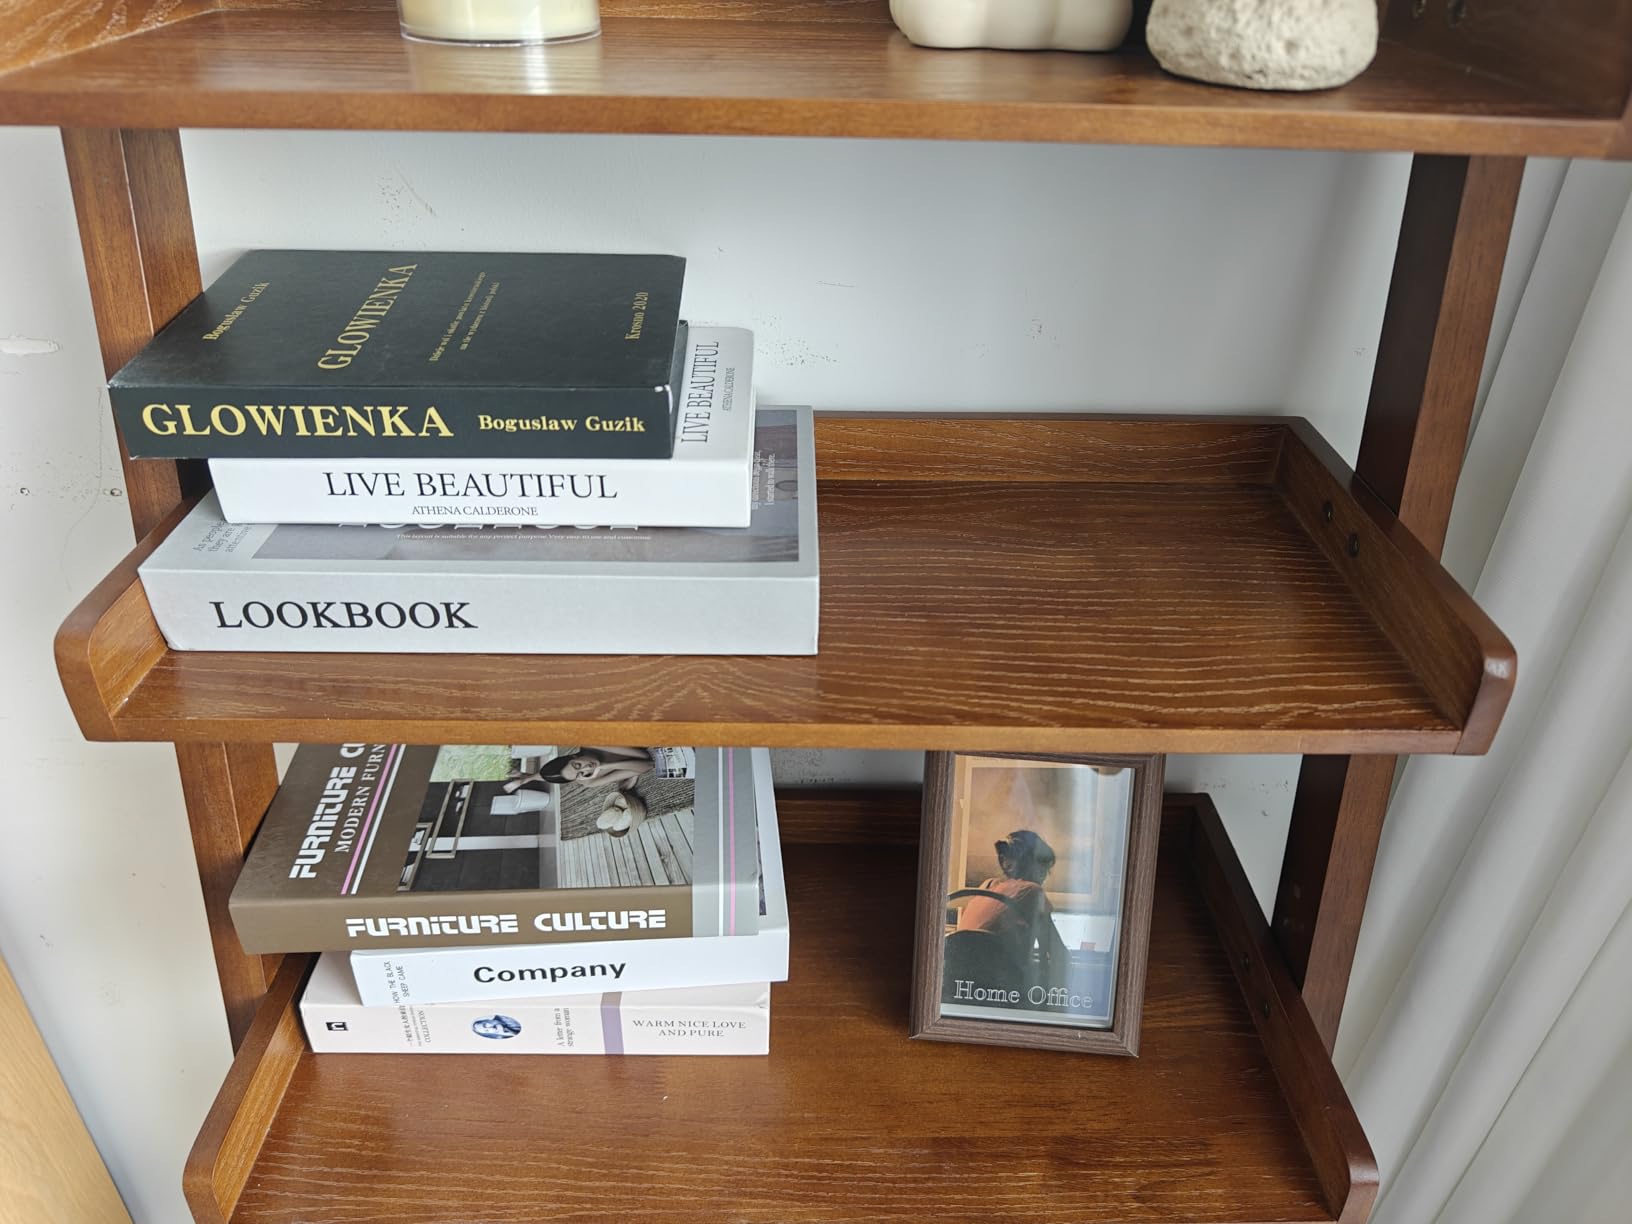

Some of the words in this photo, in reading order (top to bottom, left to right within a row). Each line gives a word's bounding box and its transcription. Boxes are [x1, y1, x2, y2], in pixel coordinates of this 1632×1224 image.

[240, 282, 270, 303] Guzik
[632, 292, 648, 310] 2020
[317, 263, 418, 370] GLOWIENKA
[625, 312, 645, 339] Krosno
[687, 341, 719, 408] BEAUTIFUL
[141, 403, 455, 438] GLOWIENKA
[477, 414, 578, 433] Boguslaw
[585, 415, 647, 433] Guzik
[681, 412, 711, 443] LIVE
[323, 472, 405, 497] LIVE
[413, 472, 618, 499] BEAUTIFUL
[411, 505, 462, 517] ATHENA
[462, 505, 539, 517] CALDERONE
[210, 601, 479, 629] LOOKBOOK
[288, 766, 358, 878] FURNITURE
[334, 785, 372, 853] MODERN
[345, 913, 519, 938] FURNITURE
[534, 909, 666, 932] CULTURE
[383, 960, 395, 978] BLACK
[474, 962, 627, 984] Company
[388, 979, 397, 989] THE
[392, 990, 401, 1004] HOW
[400, 982, 410, 997] SHEEP
[953, 979, 1021, 1005] Home
[1027, 985, 1093, 1009] Office
[418, 1010, 432, 1043] COLLECTION
[554, 1012, 562, 1025] from
[632, 1019, 674, 1027] WARM
[677, 1019, 709, 1028] NICE
[712, 1020, 747, 1029] LOVE
[689, 1029, 724, 1037] PURE
